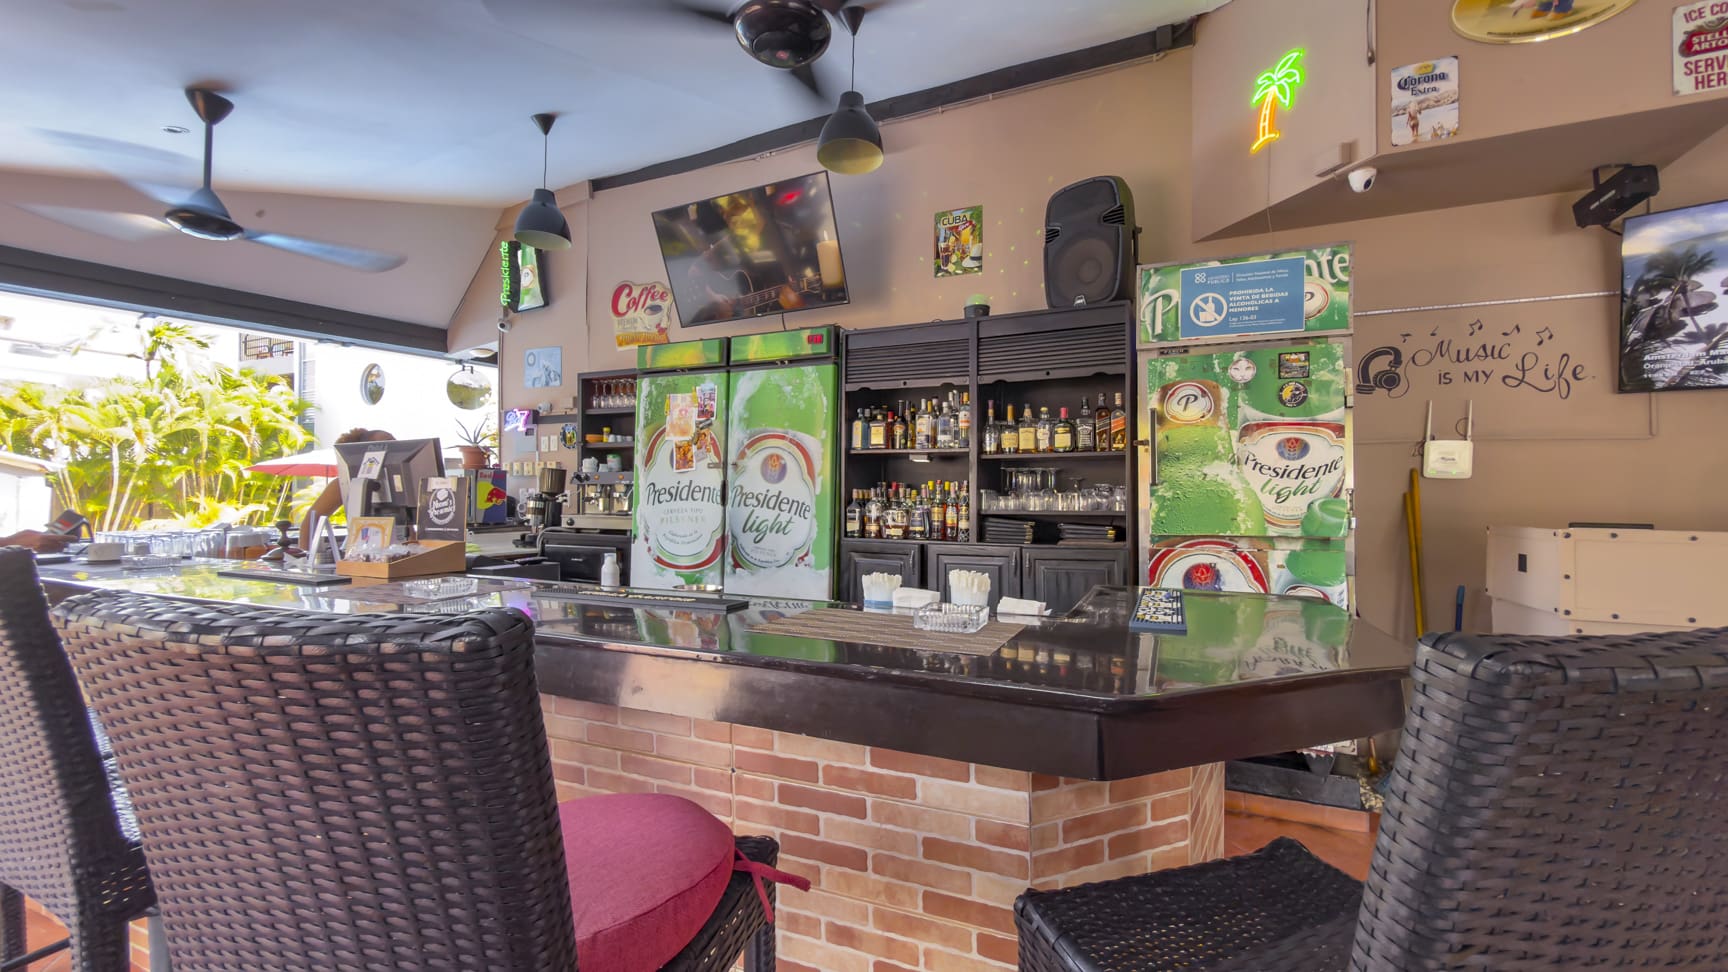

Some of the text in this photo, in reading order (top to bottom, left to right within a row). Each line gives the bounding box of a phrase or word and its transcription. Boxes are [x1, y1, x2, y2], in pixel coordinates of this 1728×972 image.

[1683, 6, 1706, 24] ICE
[1397, 72, 1447, 90] Corona
[1411, 86, 1438, 96] Extra
[942, 214, 968, 226] CUBA
[500, 240, 511, 306] Presidente
[611, 283, 669, 318] Coffee
[1229, 288, 1264, 296] PROHIBIDA
[1412, 338, 1512, 367] Music
[1464, 369, 1494, 385] MY
[1177, 393, 1198, 412] P
[1244, 450, 1343, 480] Presidente
[646, 480, 720, 506] Presidente
[731, 484, 811, 520] Presidente
[1261, 478, 1321, 504] light
[742, 509, 794, 544] light
